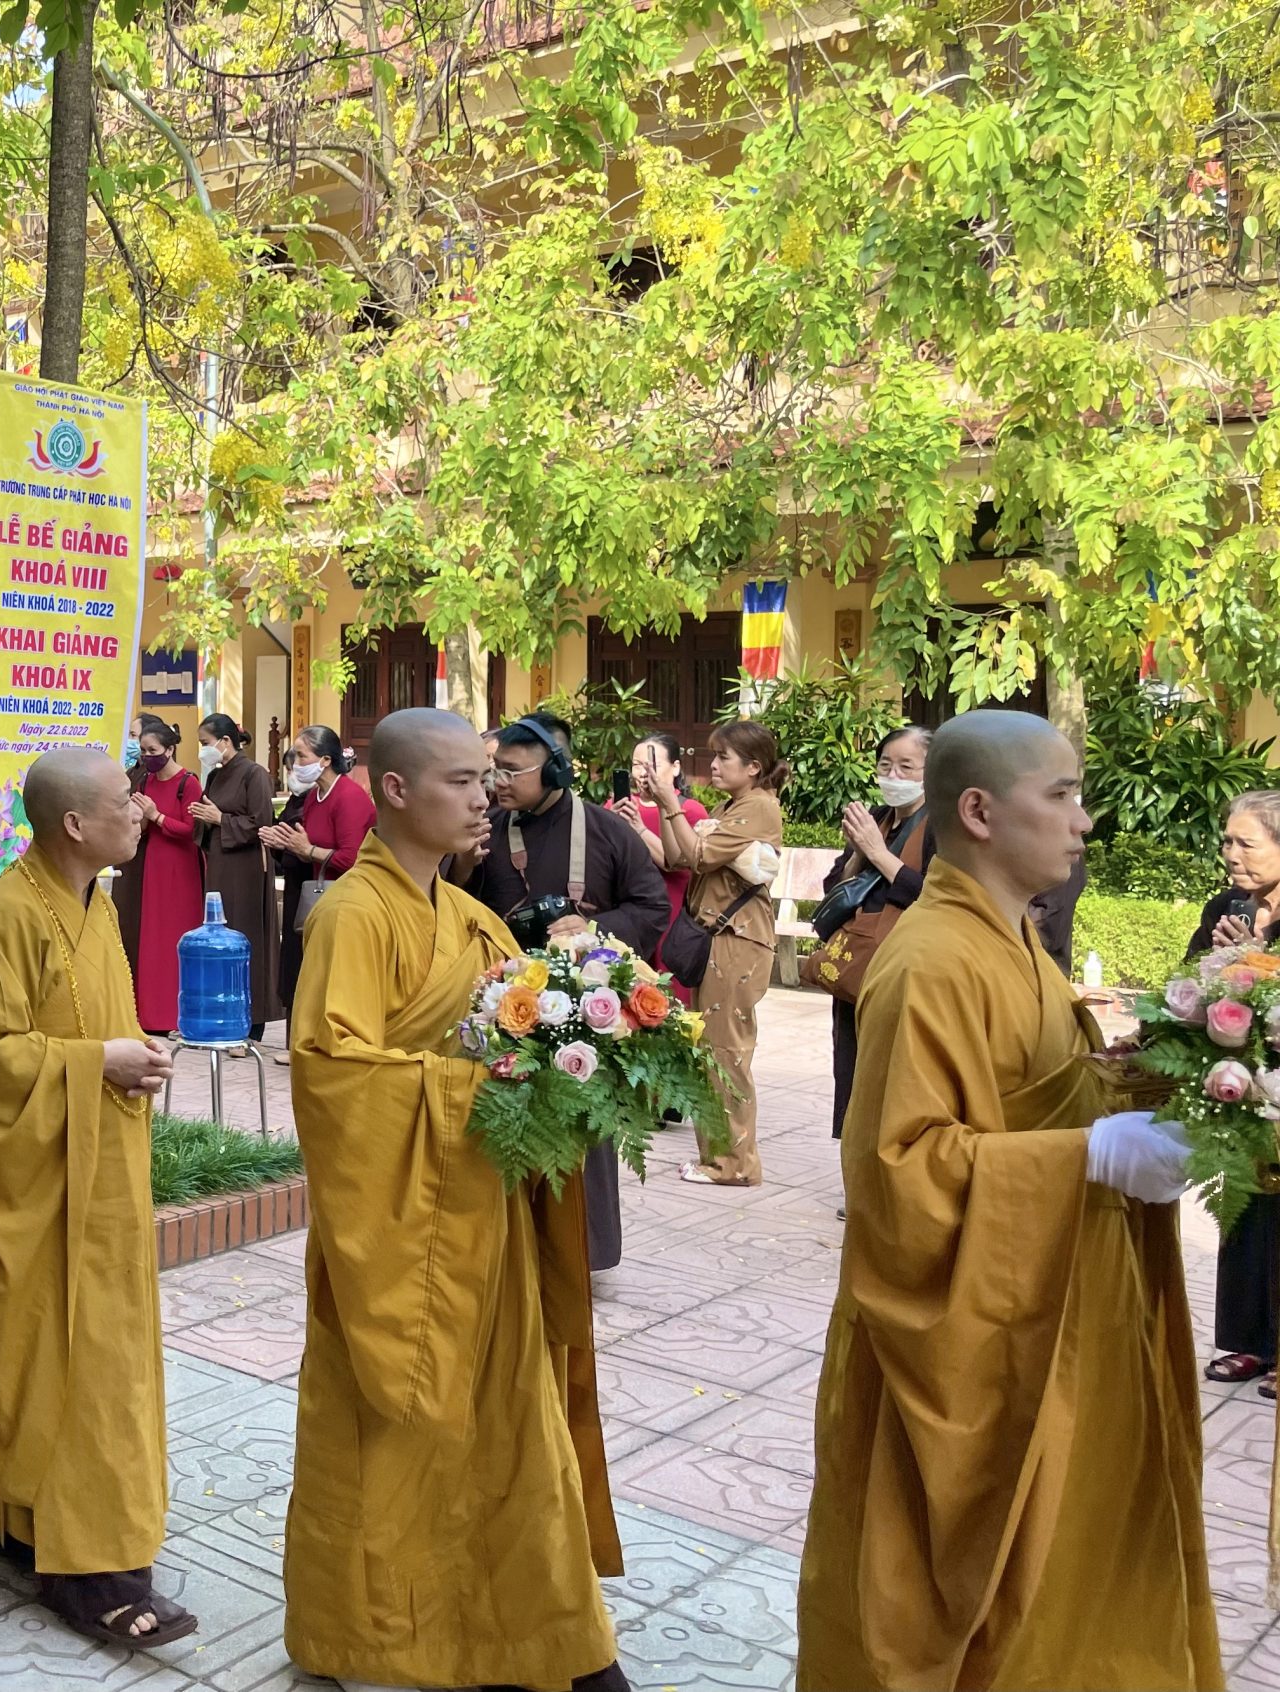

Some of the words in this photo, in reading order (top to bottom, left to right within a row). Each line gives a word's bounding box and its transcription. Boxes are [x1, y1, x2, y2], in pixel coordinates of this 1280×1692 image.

[108, 402, 125, 411] NAM
[28, 483, 51, 499] TRUNG
[88, 492, 106, 508] HỌC
[27, 518, 57, 550] BẾ
[61, 522, 129, 557] GIẢNG
[11, 558, 67, 586] KHOÁ
[72, 565, 108, 591] VIII
[1, 591, 25, 610] NIÊN
[27, 594, 56, 613] KHOÁ
[57, 598, 77, 614] 2018
[85, 601, 114, 618] 2022
[53, 625, 119, 659] GIẢNG
[12, 662, 68, 690] KHOÁ
[72, 669, 93, 692] IX
[22, 697, 50, 715] KHOÁ
[52, 701, 73, 716] 2022
[79, 702, 104, 717] 2026
[19, 722, 46, 737] Ngày
[10, 741, 35, 754] ngày
[35, 741, 58, 752] 245
